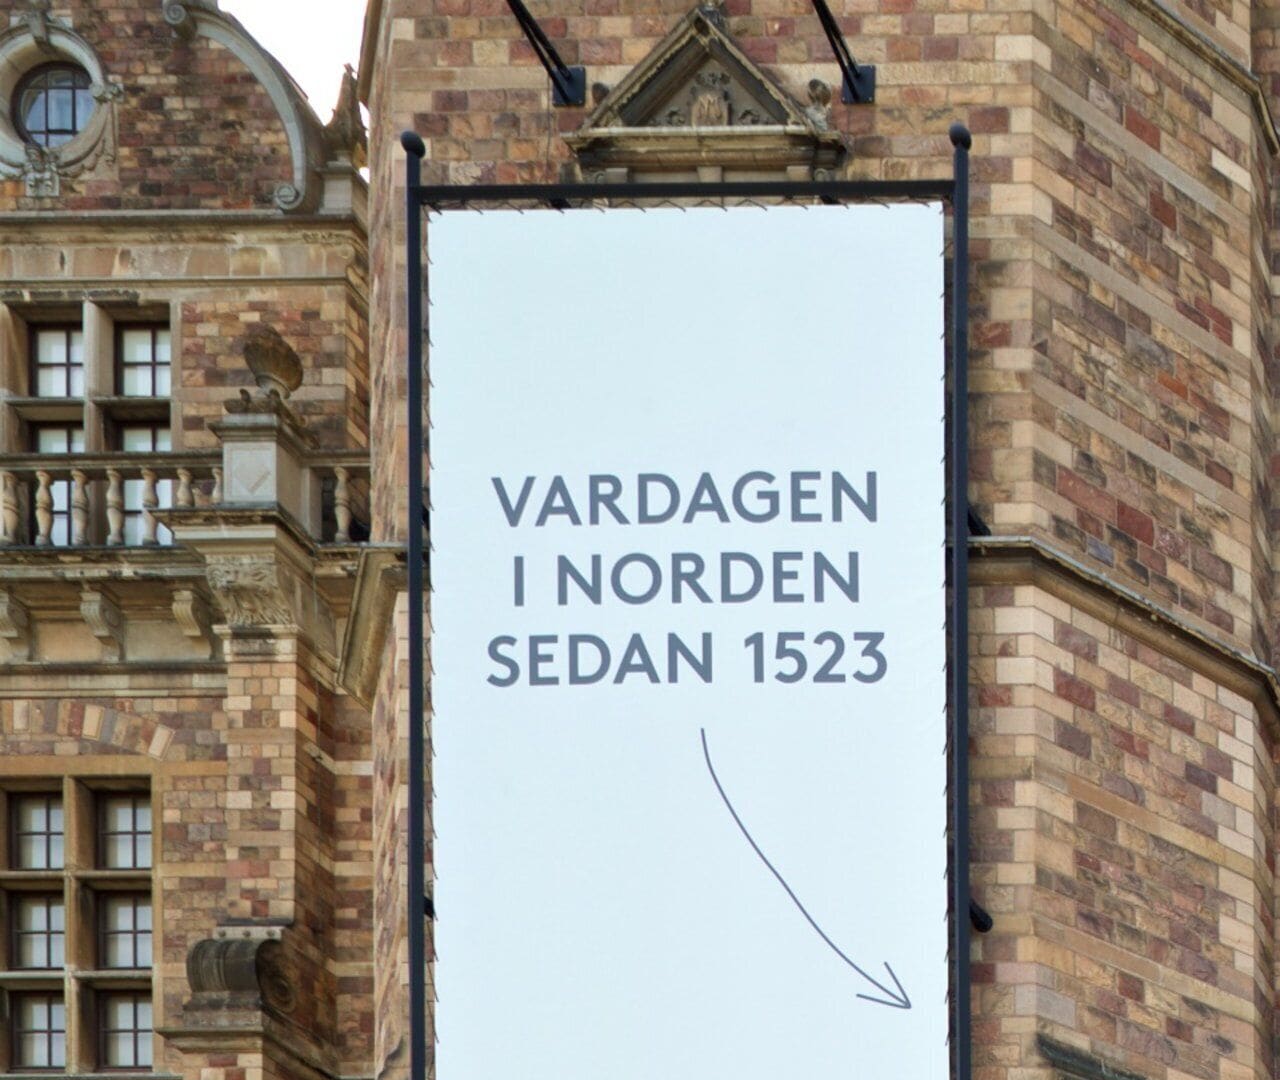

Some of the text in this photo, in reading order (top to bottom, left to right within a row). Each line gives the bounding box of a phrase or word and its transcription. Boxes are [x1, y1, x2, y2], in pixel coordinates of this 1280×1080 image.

[490, 470, 878, 528] VARDAGEN
[513, 550, 860, 607] I NORDEN
[486, 630, 888, 688] SEDAN 1523
